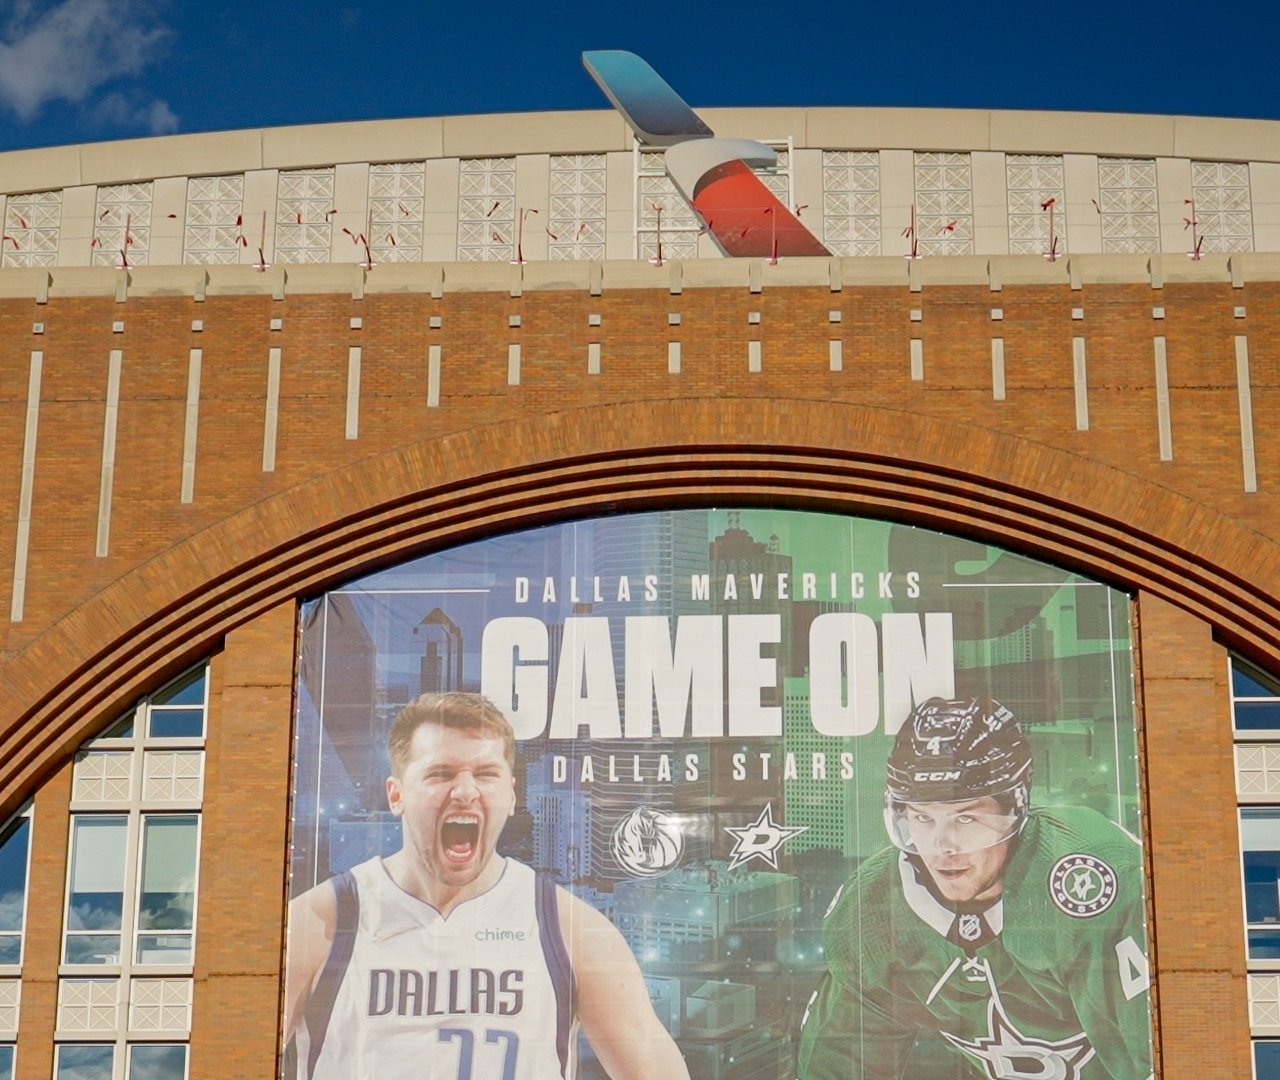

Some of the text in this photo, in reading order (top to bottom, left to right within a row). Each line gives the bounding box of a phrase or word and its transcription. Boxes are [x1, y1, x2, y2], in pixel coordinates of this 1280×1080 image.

[515, 572, 921, 603] DALLAS MAVERICKS
[480, 611, 956, 741] GAME ON
[926, 736, 941, 755] 4
[553, 752, 854, 783] DALLAS STARS
[914, 771, 961, 781] CCM
[1054, 858, 1095, 903] DALLAS
[475, 928, 525, 941] chime
[367, 968, 524, 1017] DALLAS
